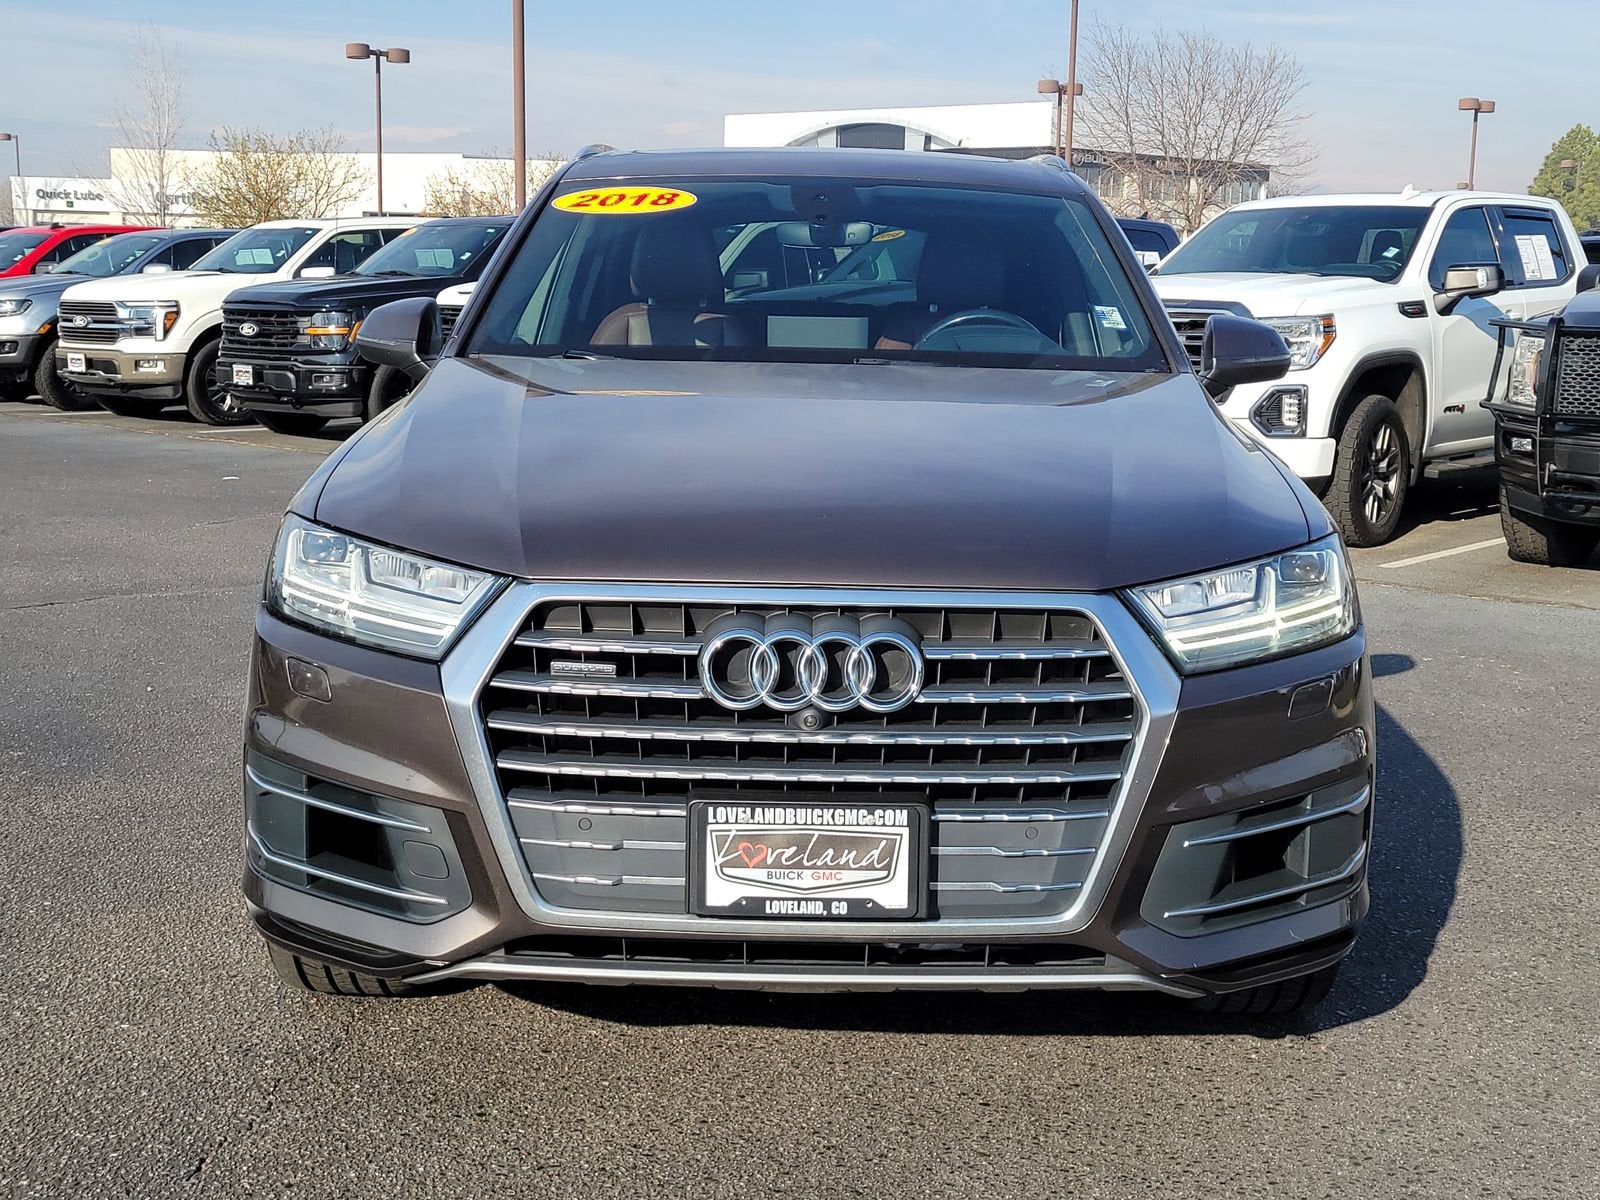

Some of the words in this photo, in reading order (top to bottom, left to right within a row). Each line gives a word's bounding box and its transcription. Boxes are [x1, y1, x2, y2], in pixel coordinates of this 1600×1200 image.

[36, 188, 72, 200] Quick
[73, 190, 105, 201] Lube
[568, 193, 680, 208] 2018
[707, 806, 908, 827] LOVELANDBUICKGMC.COM
[766, 870, 804, 881] BUICK
[810, 870, 843, 881] GMC
[765, 900, 827, 916] LOVELAND,
[831, 901, 848, 915] CO
